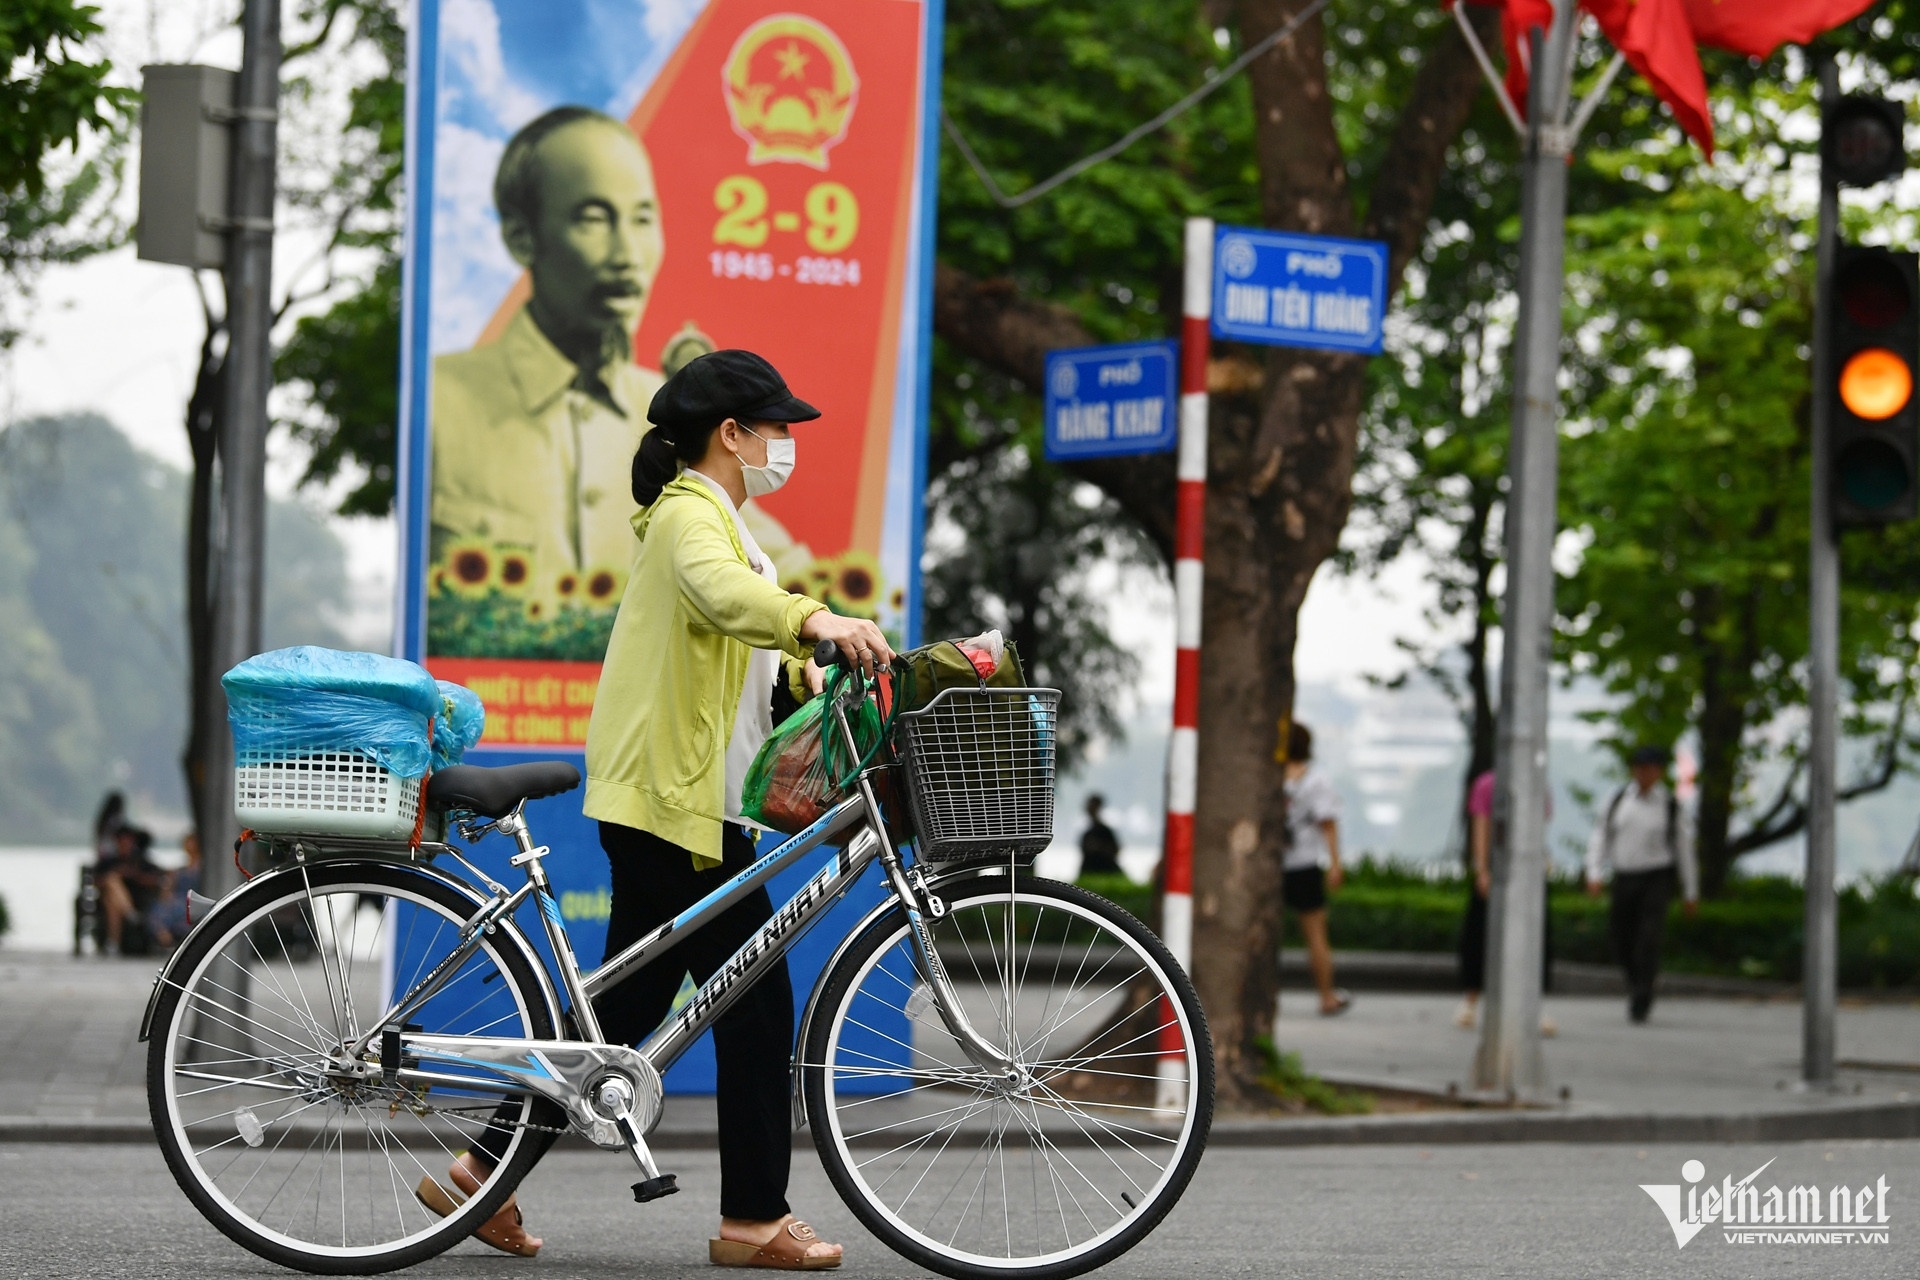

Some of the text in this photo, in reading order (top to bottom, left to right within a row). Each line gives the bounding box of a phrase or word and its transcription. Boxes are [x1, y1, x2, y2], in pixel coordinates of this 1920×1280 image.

[710, 251, 774, 281] 1945
[795, 256, 861, 286] 2024
[738, 828, 814, 882] CONSTELLATION
[678, 868, 827, 1032] THONG NHAT
[602, 965, 625, 983] SINCE
[406, 1043, 437, 1055] SINCE
